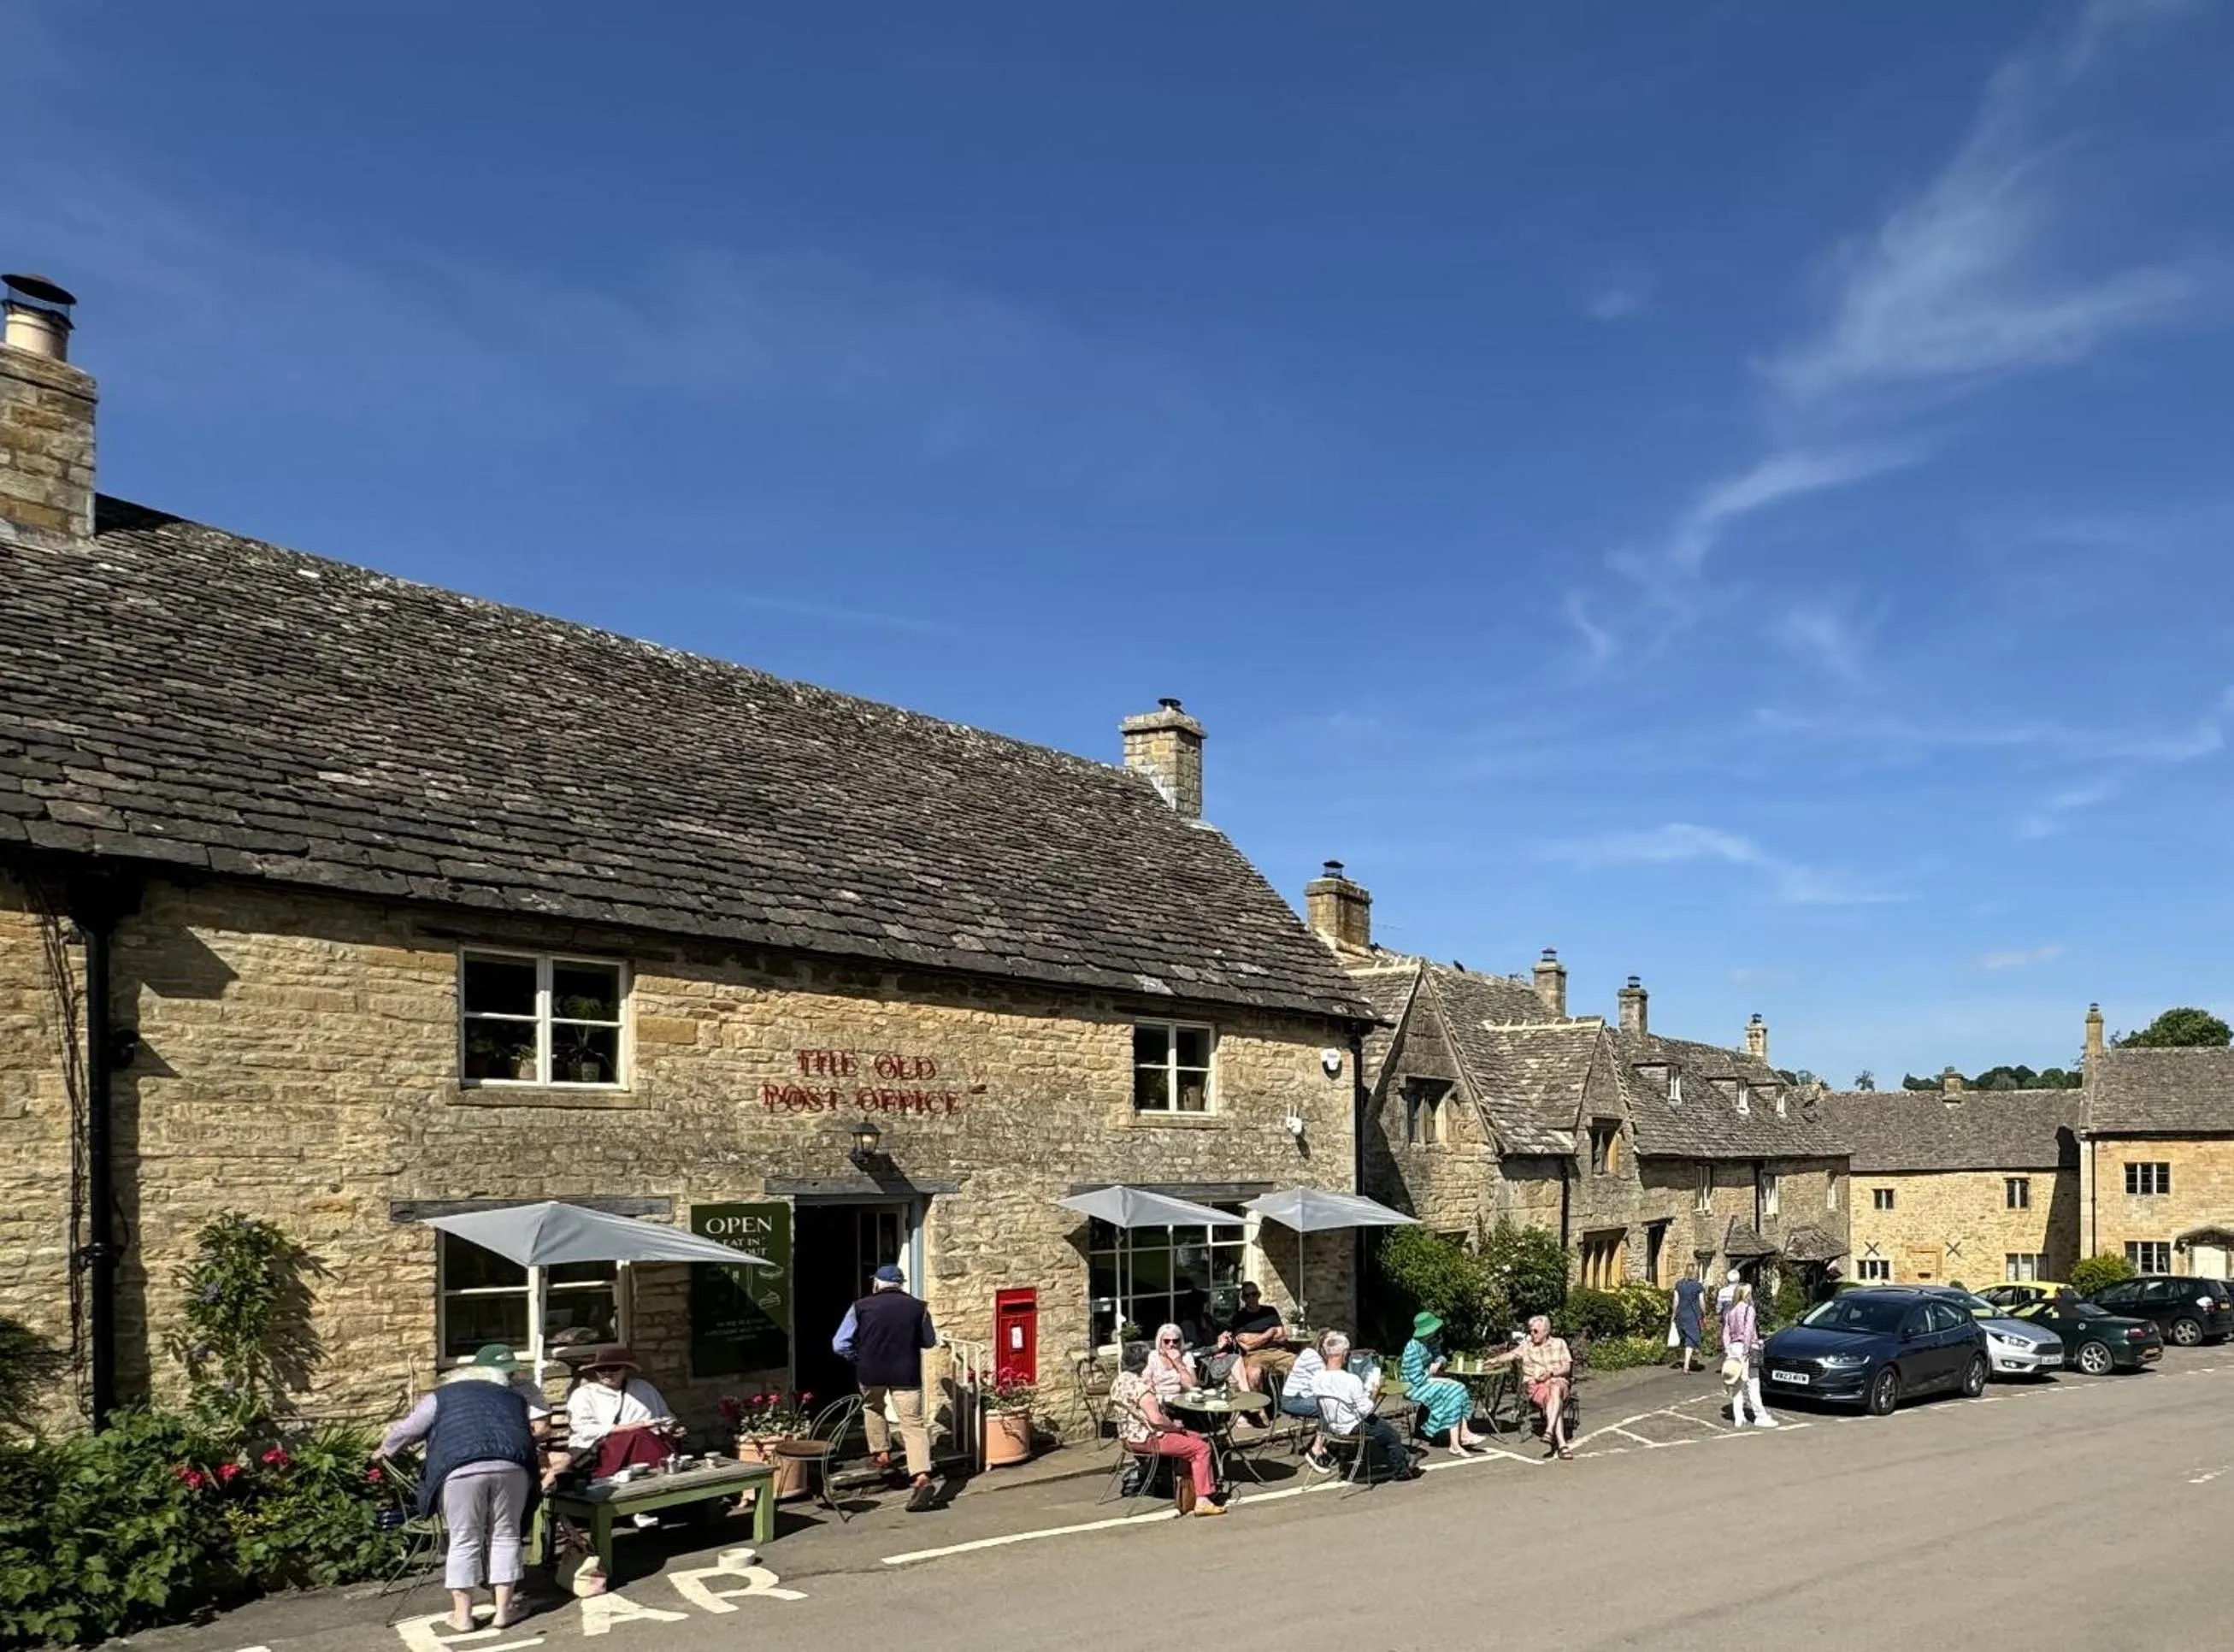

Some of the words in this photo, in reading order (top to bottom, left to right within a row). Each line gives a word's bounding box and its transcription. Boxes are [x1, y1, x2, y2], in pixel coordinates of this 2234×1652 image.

[797, 1049, 858, 1077] THE
[874, 1052, 935, 1080] OLD
[762, 1083, 844, 1112] POST
[857, 1087, 960, 1114] OFFICE
[705, 1216, 772, 1234] OPEN
